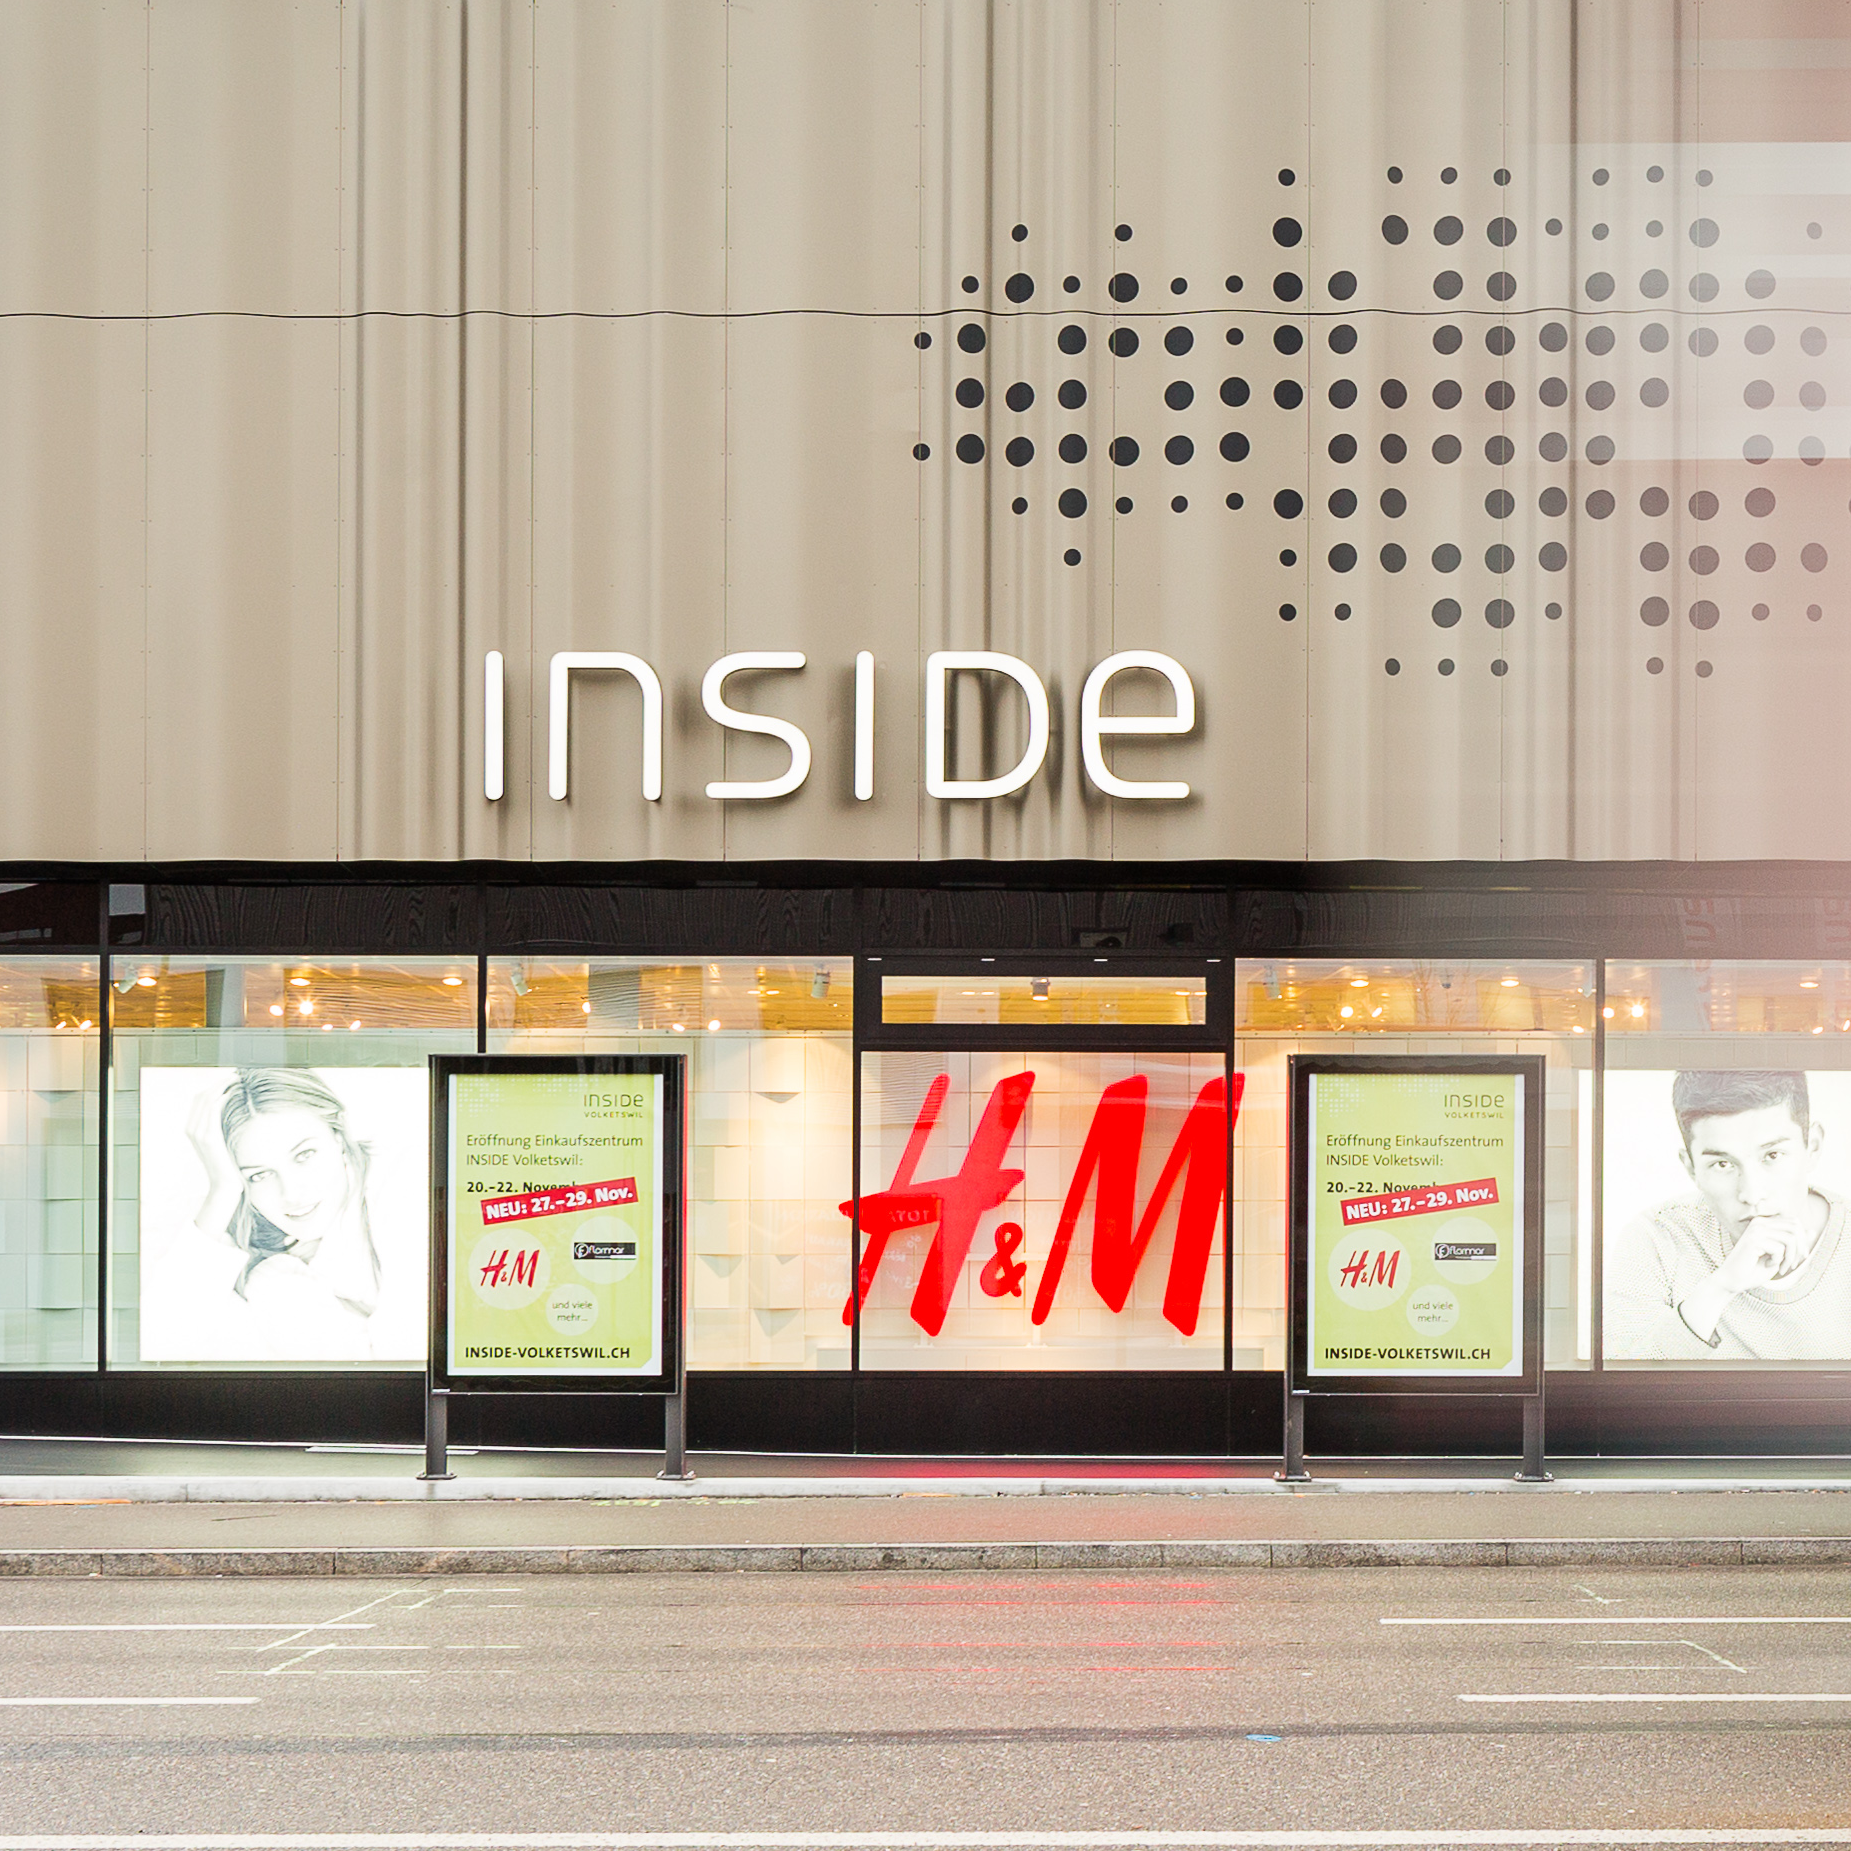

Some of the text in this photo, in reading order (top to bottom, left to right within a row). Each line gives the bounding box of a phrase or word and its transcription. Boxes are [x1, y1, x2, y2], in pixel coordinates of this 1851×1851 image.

[584, 1111, 643, 1119] VOLKETSWIL
[1444, 1111, 1503, 1119] VOLKETSWIL
[466, 1134, 643, 1149] Eröffnung Einkaufszentrum
[1326, 1134, 1503, 1149] Eröffnung Einkaufszentrum
[466, 1154, 583, 1166] INSIDE Volketswil:
[1326, 1154, 1443, 1166] INSIDE Volketswil:
[485, 1201, 527, 1219] NEU:
[595, 1187, 634, 1202] Nov.
[838, 1070, 1245, 1337] H&M
[1345, 1201, 1387, 1219] NEU:
[1455, 1187, 1494, 1202] Nov.
[480, 1249, 540, 1288] H&M
[1340, 1249, 1400, 1288] H&M
[552, 1301, 593, 1309] und viele
[1412, 1302, 1453, 1310] und viele
[465, 1347, 630, 1359] INSIDE-VOLKETSWIL.CH
[1325, 1348, 1490, 1360] INSIDE-VOLKETSWIL.CH
